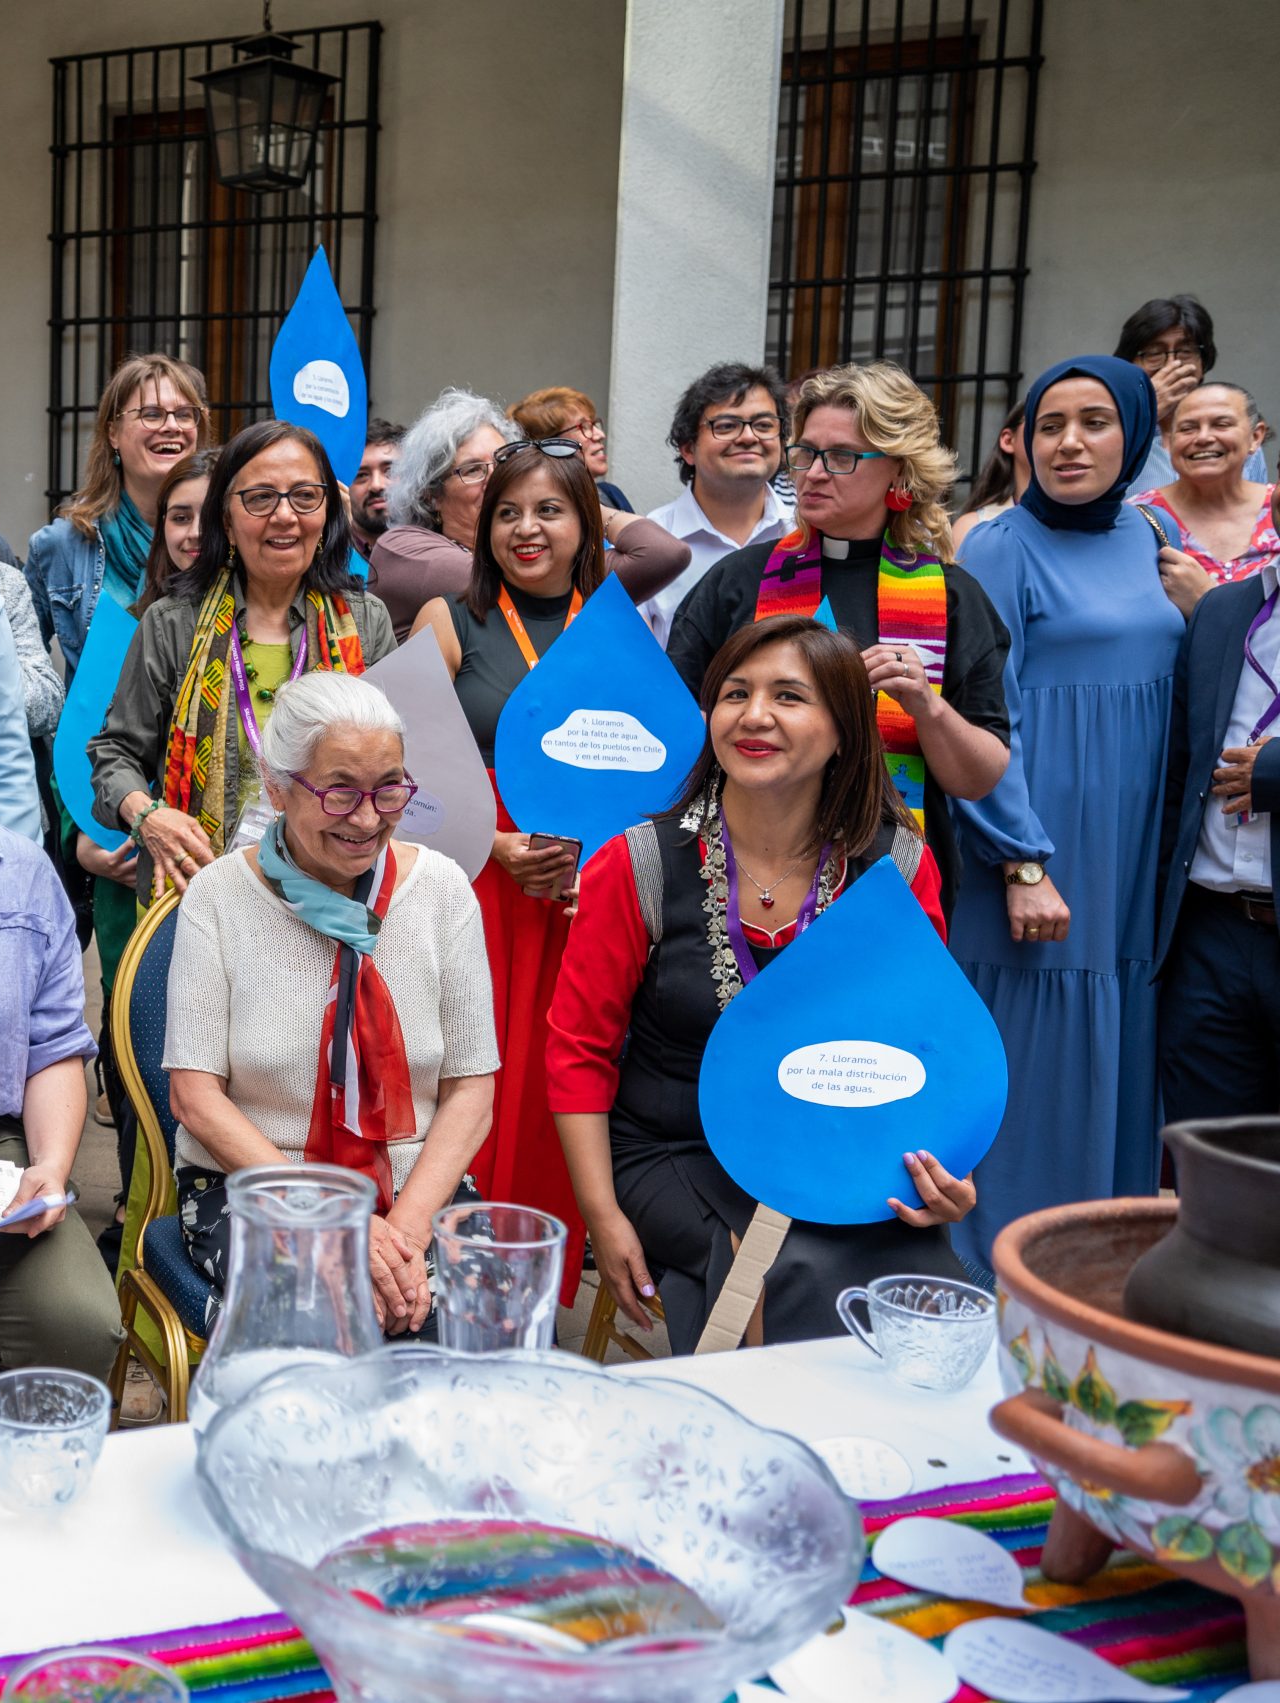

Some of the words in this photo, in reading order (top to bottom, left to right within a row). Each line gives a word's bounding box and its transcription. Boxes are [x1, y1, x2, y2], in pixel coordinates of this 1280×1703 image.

[591, 718, 624, 727] Lloramos
[581, 729, 589, 737] la
[590, 730, 608, 738] falta
[621, 733, 638, 741] agua
[554, 740, 577, 748] tantos
[590, 741, 601, 750] los
[602, 743, 631, 751] pueblos
[643, 745, 662, 754] Chile
[592, 753, 600, 761] el
[602, 755, 629, 763] mundo.
[819, 1053, 828, 1062] 7.
[832, 1055, 877, 1065] Lloramos
[786, 1067, 804, 1076] por
[806, 1067, 816, 1075] la
[818, 1068, 843, 1077] mala
[846, 1069, 907, 1082] distribución
[811, 1081, 824, 1090] de
[827, 1082, 841, 1091] las
[844, 1085, 875, 1094] aguas.
